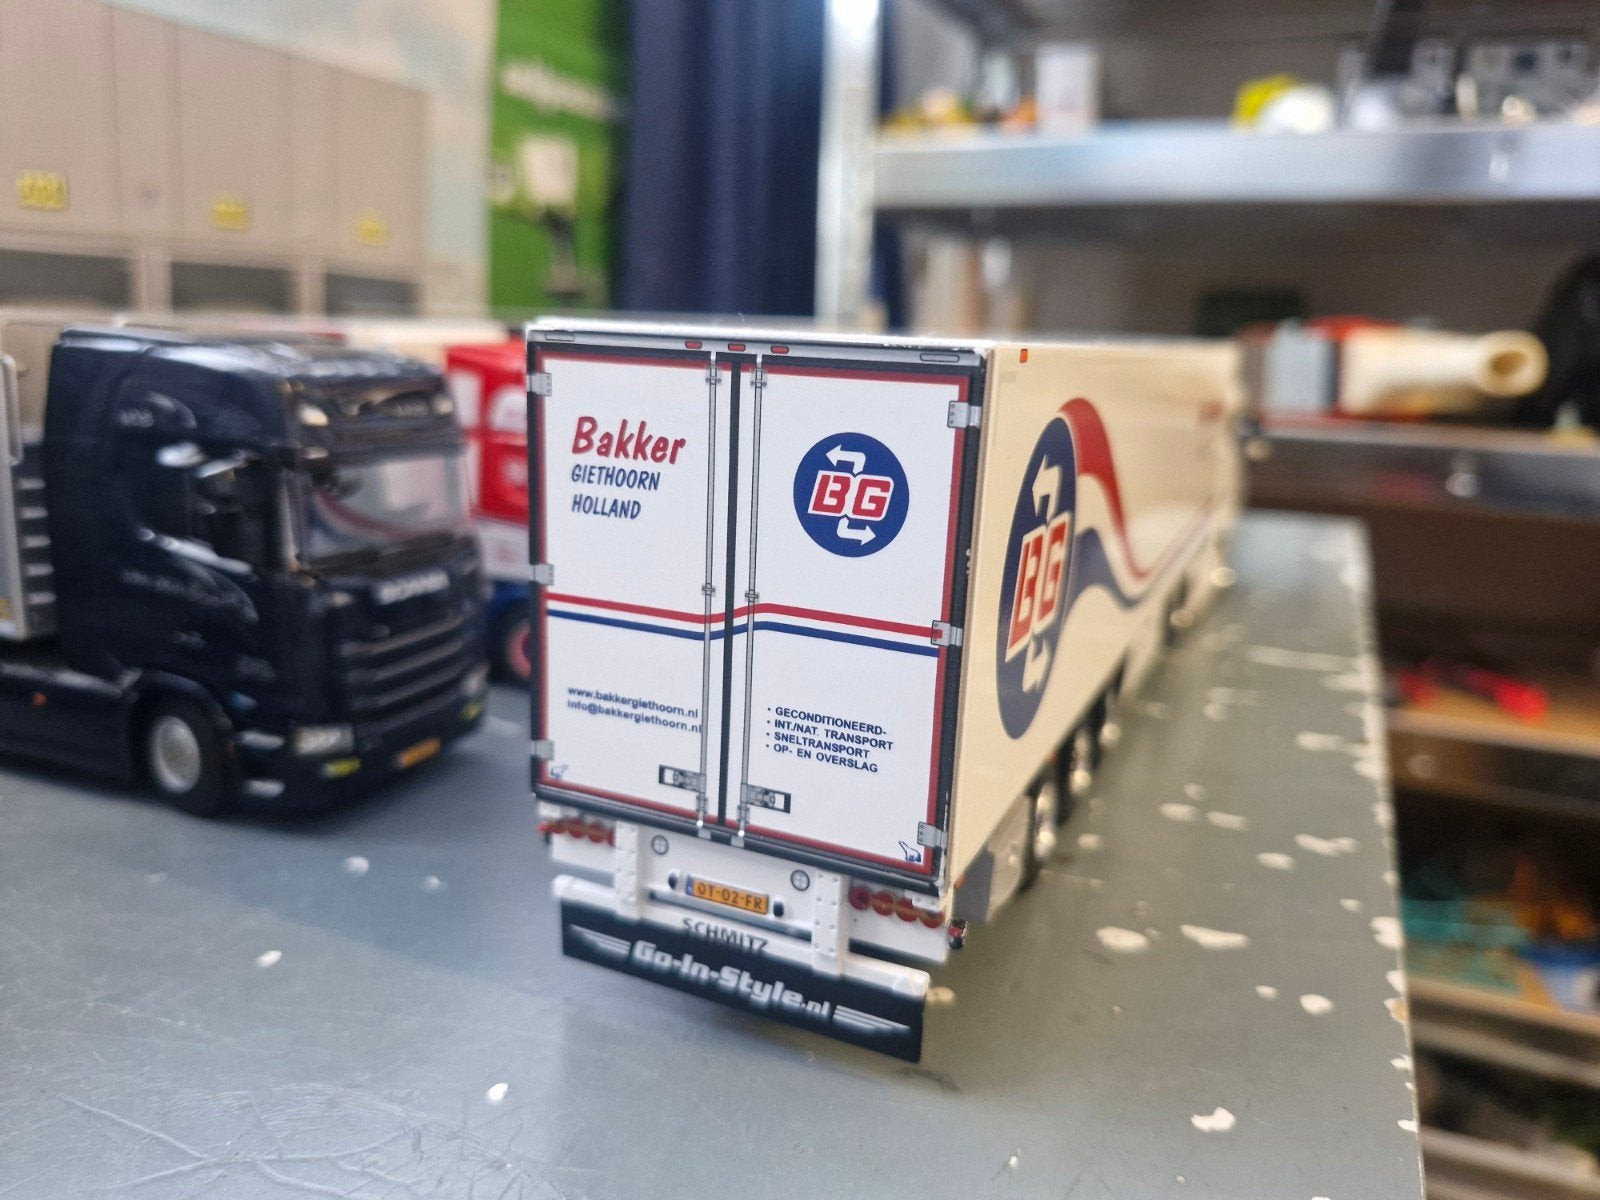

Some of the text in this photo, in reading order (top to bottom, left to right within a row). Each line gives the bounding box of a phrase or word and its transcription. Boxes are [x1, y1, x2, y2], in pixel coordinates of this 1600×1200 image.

[571, 416, 687, 465] Bakker
[571, 463, 661, 491] GIETHOORN
[571, 493, 642, 520] HOLLAND
[808, 471, 893, 520] BG
[1006, 514, 1070, 658] BG
[567, 699, 702, 733] info@bakkergiethoorn.nl
[568, 686, 699, 719] www.bakkergiethoorn.nl
[775, 706, 887, 736] GECONDITIONEERD-
[773, 731, 870, 759] SNELTRANSPORT
[824, 728, 894, 751] TRANSPORT
[773, 743, 878, 773] OP- EN OVERSLAG
[682, 916, 769, 953] SCHMITZ
[632, 938, 832, 1017] Go-In-Style.nl
